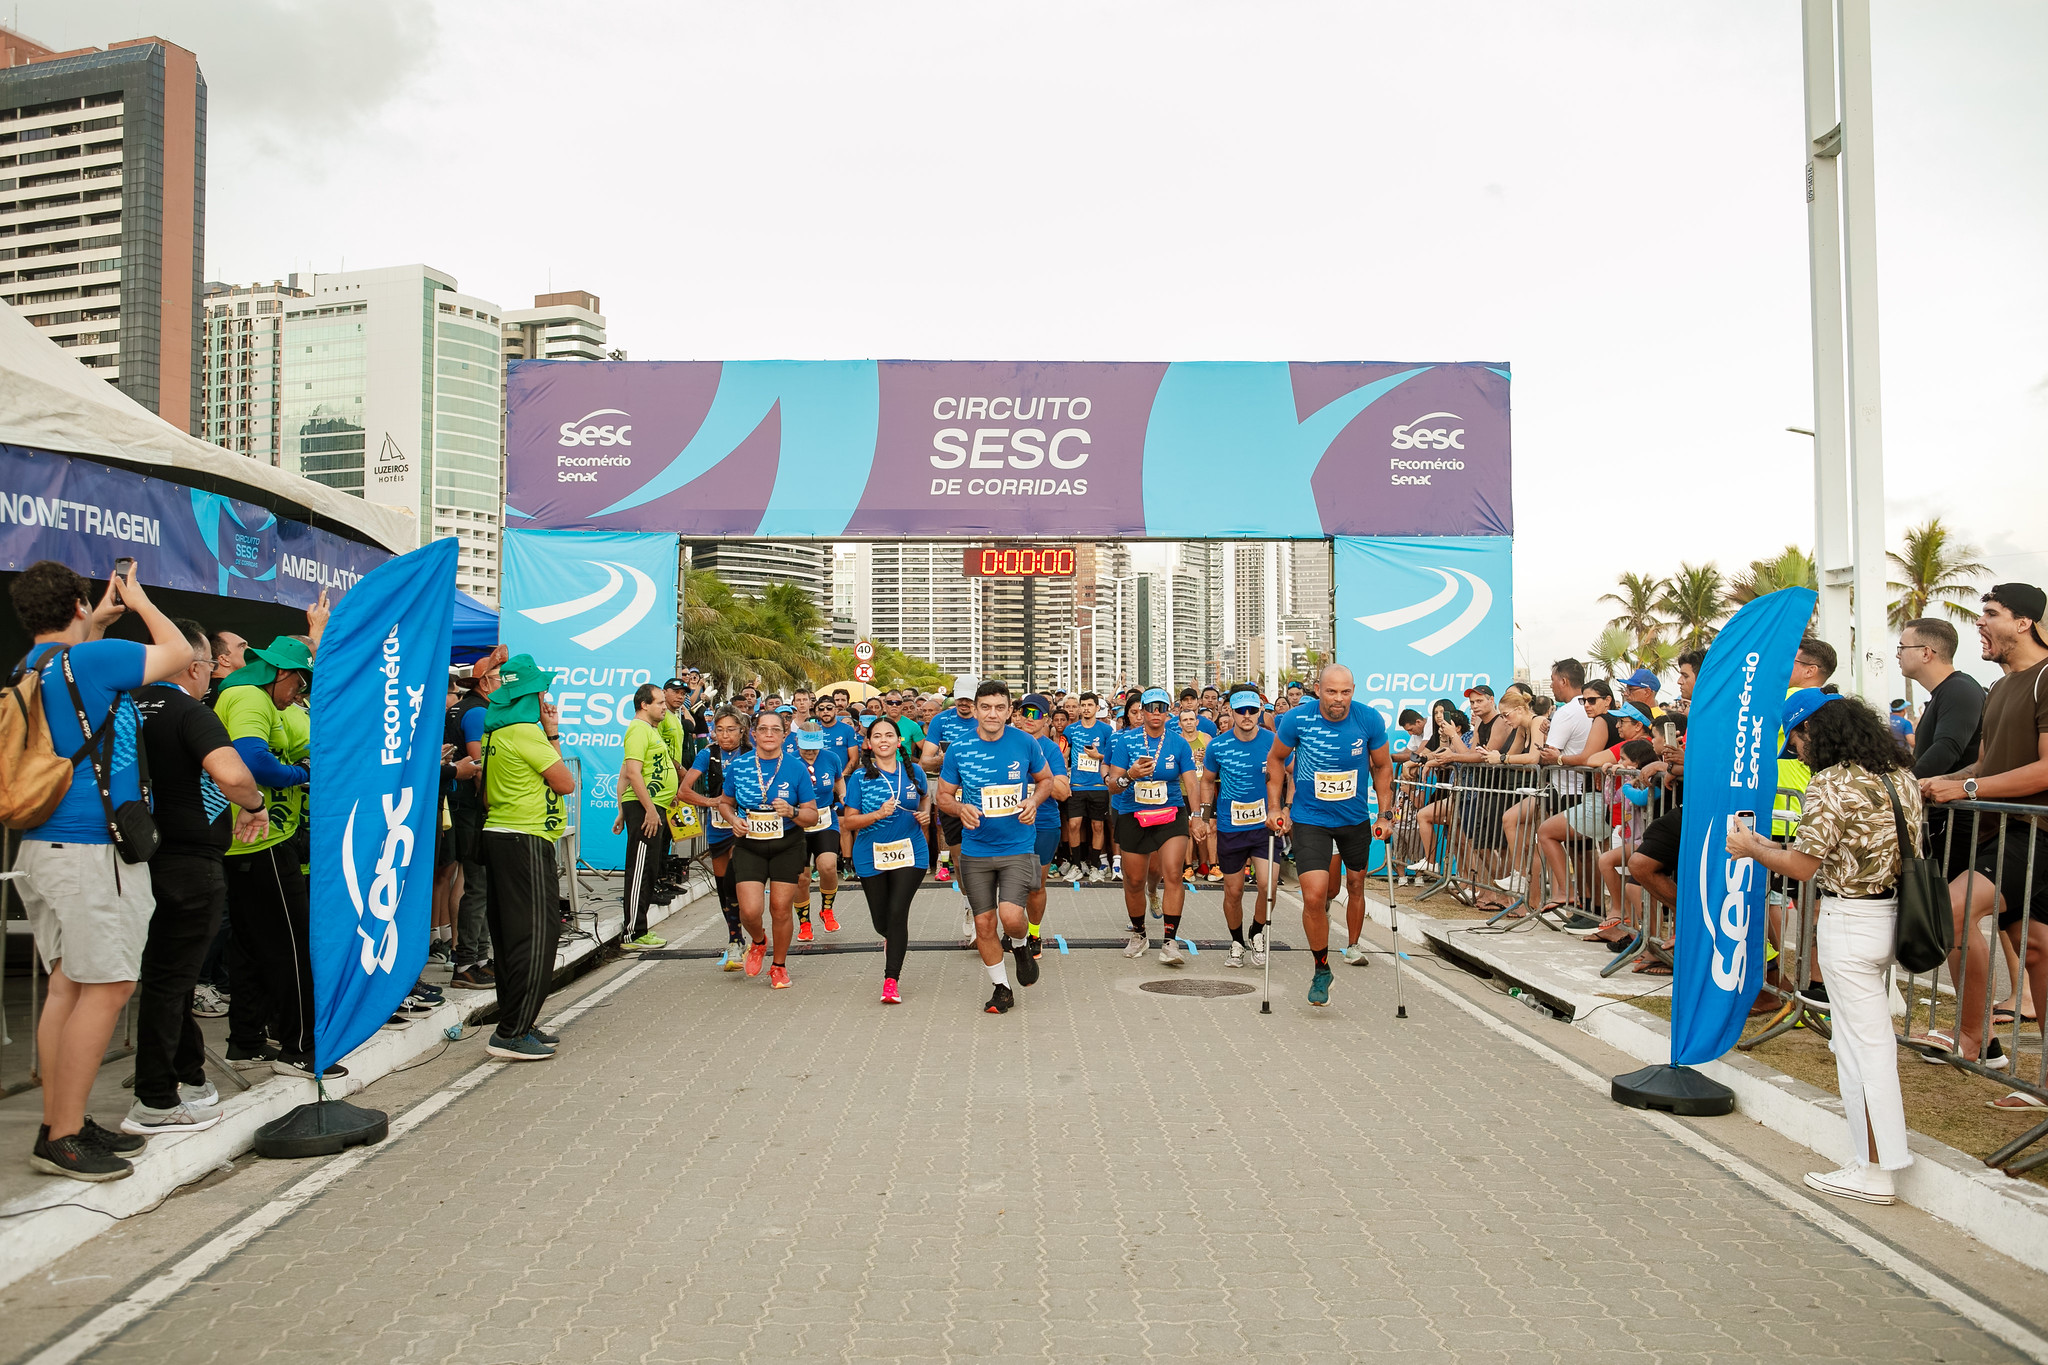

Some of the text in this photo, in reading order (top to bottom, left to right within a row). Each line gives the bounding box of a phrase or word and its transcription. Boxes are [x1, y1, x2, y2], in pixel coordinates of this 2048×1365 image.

[932, 396, 1092, 420] CIRCUITO
[557, 422, 632, 448] Sesc
[1390, 425, 1465, 451] Sesc
[929, 428, 1091, 470] SESC
[557, 454, 632, 468] Fecomércio
[1390, 457, 1465, 471] Fecomércio
[374, 464, 409, 475] LUZEIROS
[557, 471, 598, 483] Senac
[378, 475, 404, 483] HOTÉIS
[1390, 474, 1432, 486] Senac
[930, 478, 1088, 496] DE CORRIDAS
[235, 543, 259, 560] SESC
[981, 549, 1074, 575] 0:00:00
[282, 552, 365, 591] AMBULATÓ
[857, 645, 871, 654] 40
[536, 666, 652, 687] RCUITO
[1366, 673, 1491, 692] CIRCUITO
[1730, 652, 1760, 788] Fecomércio
[1747, 715, 1764, 790] Senac
[1079, 758, 1098, 768] 2494
[1140, 788, 1162, 799] 714
[1319, 780, 1352, 794] 2542
[988, 794, 1018, 809] 1188
[1235, 807, 1263, 820] 1644
[750, 821, 779, 833] 1888
[881, 850, 906, 863] 396
[1711, 814, 1755, 995] Ses
